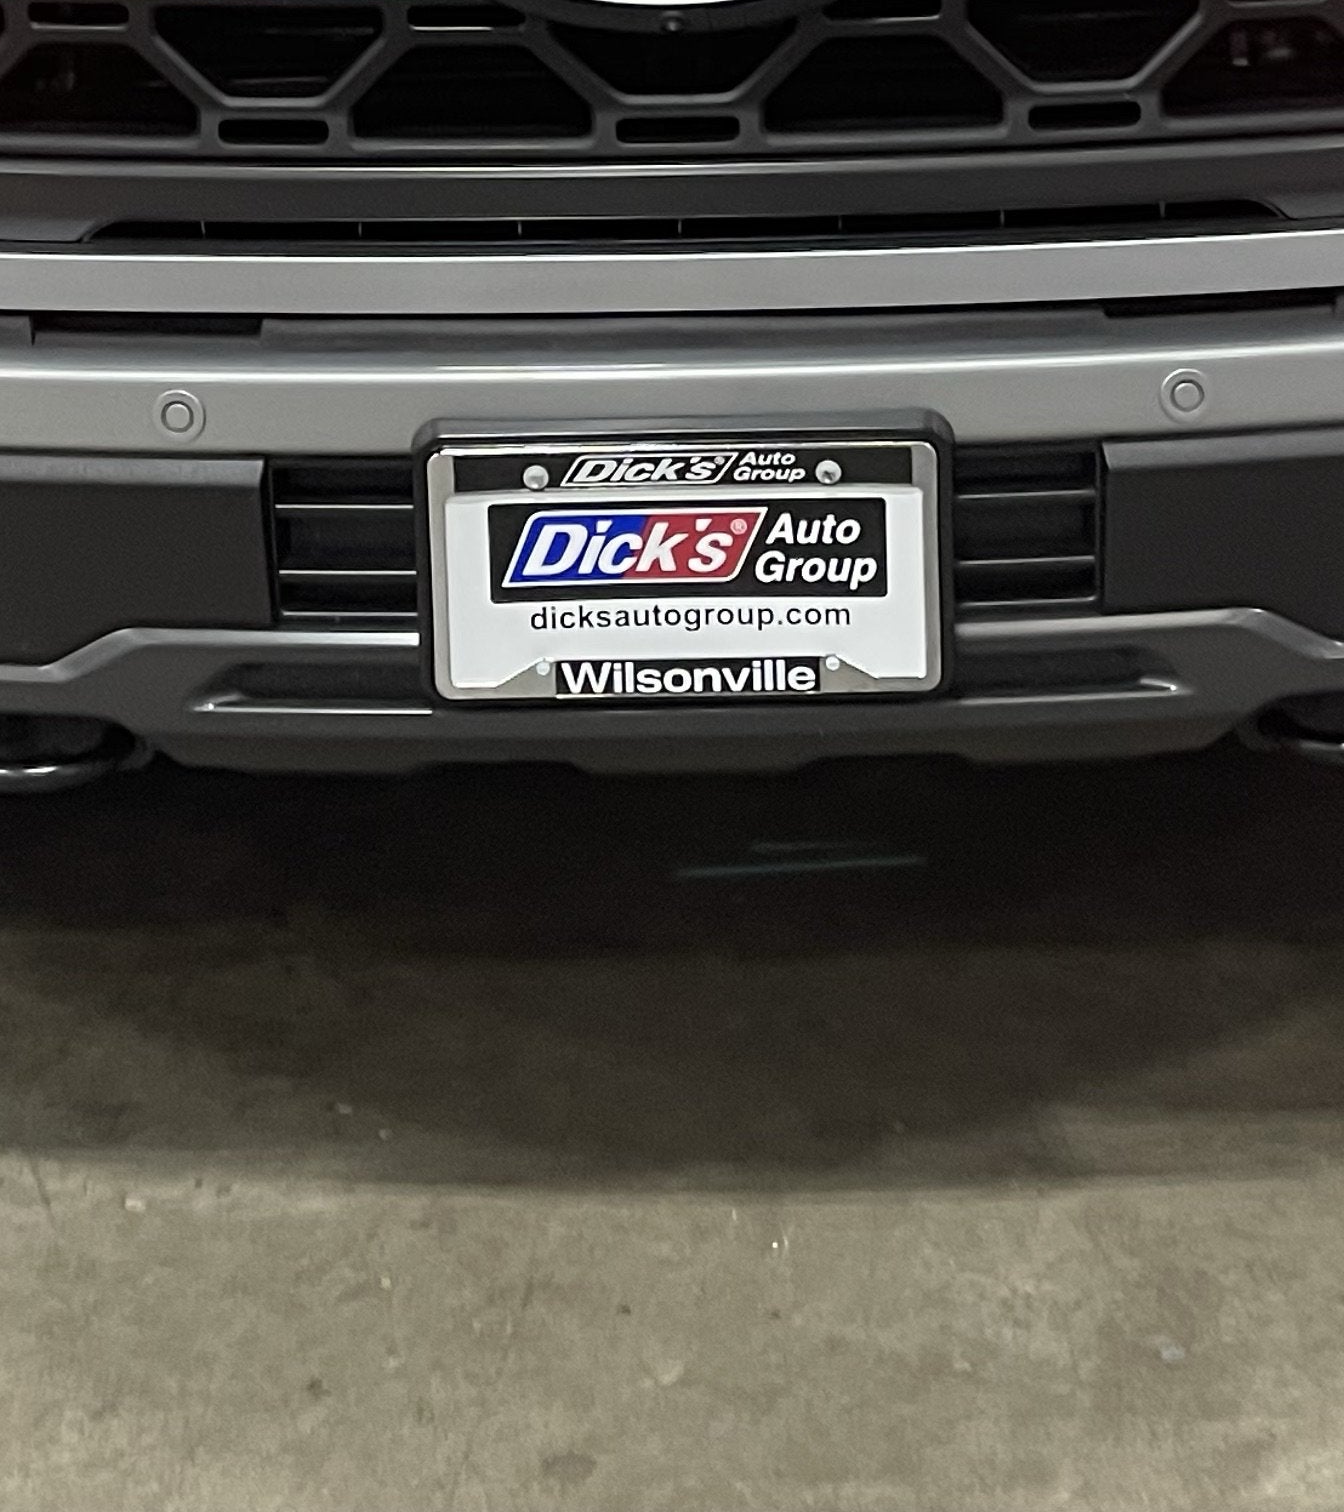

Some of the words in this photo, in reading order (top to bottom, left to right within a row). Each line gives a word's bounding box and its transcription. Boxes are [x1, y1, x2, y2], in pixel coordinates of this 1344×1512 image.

[575, 456, 716, 483] Dick's
[739, 451, 796, 466] Auto
[733, 466, 806, 483] Group
[766, 513, 861, 546] Auto
[523, 518, 733, 576] Dick's
[755, 551, 877, 590] Group
[530, 604, 851, 631] dicksautogroup.com
[561, 660, 816, 694] Wilsonville
